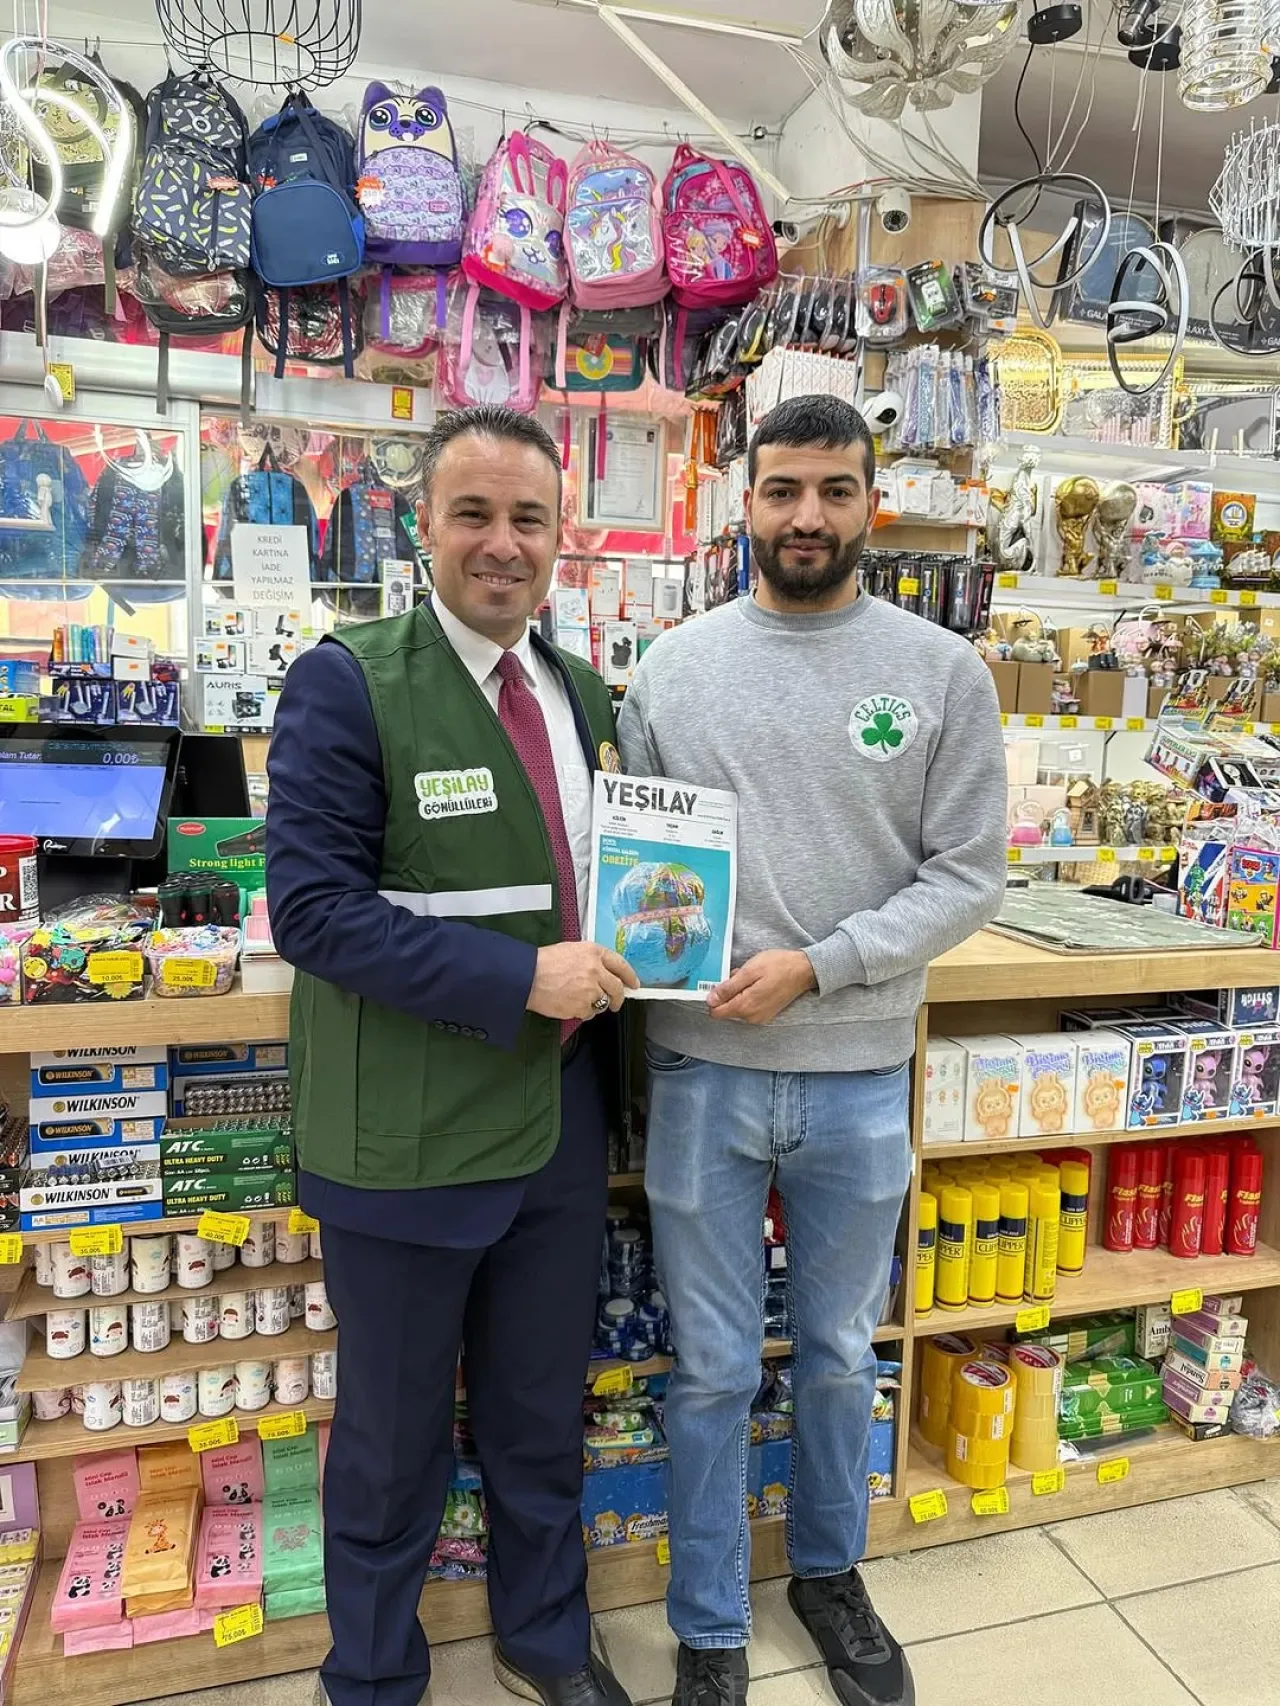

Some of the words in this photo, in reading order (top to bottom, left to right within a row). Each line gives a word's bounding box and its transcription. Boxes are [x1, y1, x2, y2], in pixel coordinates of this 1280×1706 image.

[256, 533, 283, 545] KREDİ
[252, 549, 289, 557] KARTINA
[250, 576, 295, 585] YAPILMAZ
[206, 680, 243, 690] AURIS
[854, 697, 911, 723] CELTICS
[419, 773, 490, 799] YEŞİLAY
[602, 778, 698, 816] YEŞİLAY
[423, 796, 493, 815] GÖNÜLLÜLERİ
[189, 858, 228, 870] Strong
[229, 857, 257, 869] light
[67, 1045, 137, 1058] WILKINSON
[54, 1070, 93, 1080] WILKINSON
[66, 1096, 137, 1113] WILKINSON
[54, 1126, 93, 1136] WILKINSON
[165, 1140, 205, 1154] ATC
[163, 1158, 185, 1166] ULTRA
[185, 1156, 206, 1164] HEAVY
[168, 1178, 207, 1193] ATC
[1112, 1186, 1138, 1197] Flas
[1138, 1184, 1161, 1194] Flas
[45, 1187, 110, 1204] WILKINSON
[166, 1197, 187, 1206] ULTRA
[187, 1195, 208, 1204] HEAVY
[209, 1193, 226, 1201] DUTY
[1237, 1190, 1261, 1200] Flas
[1061, 1216, 1086, 1226] CLIPPE
[84, 1479, 102, 1487] Islak
[103, 1471, 129, 1483] Mendil
[631, 1517, 668, 1531] Freshma
